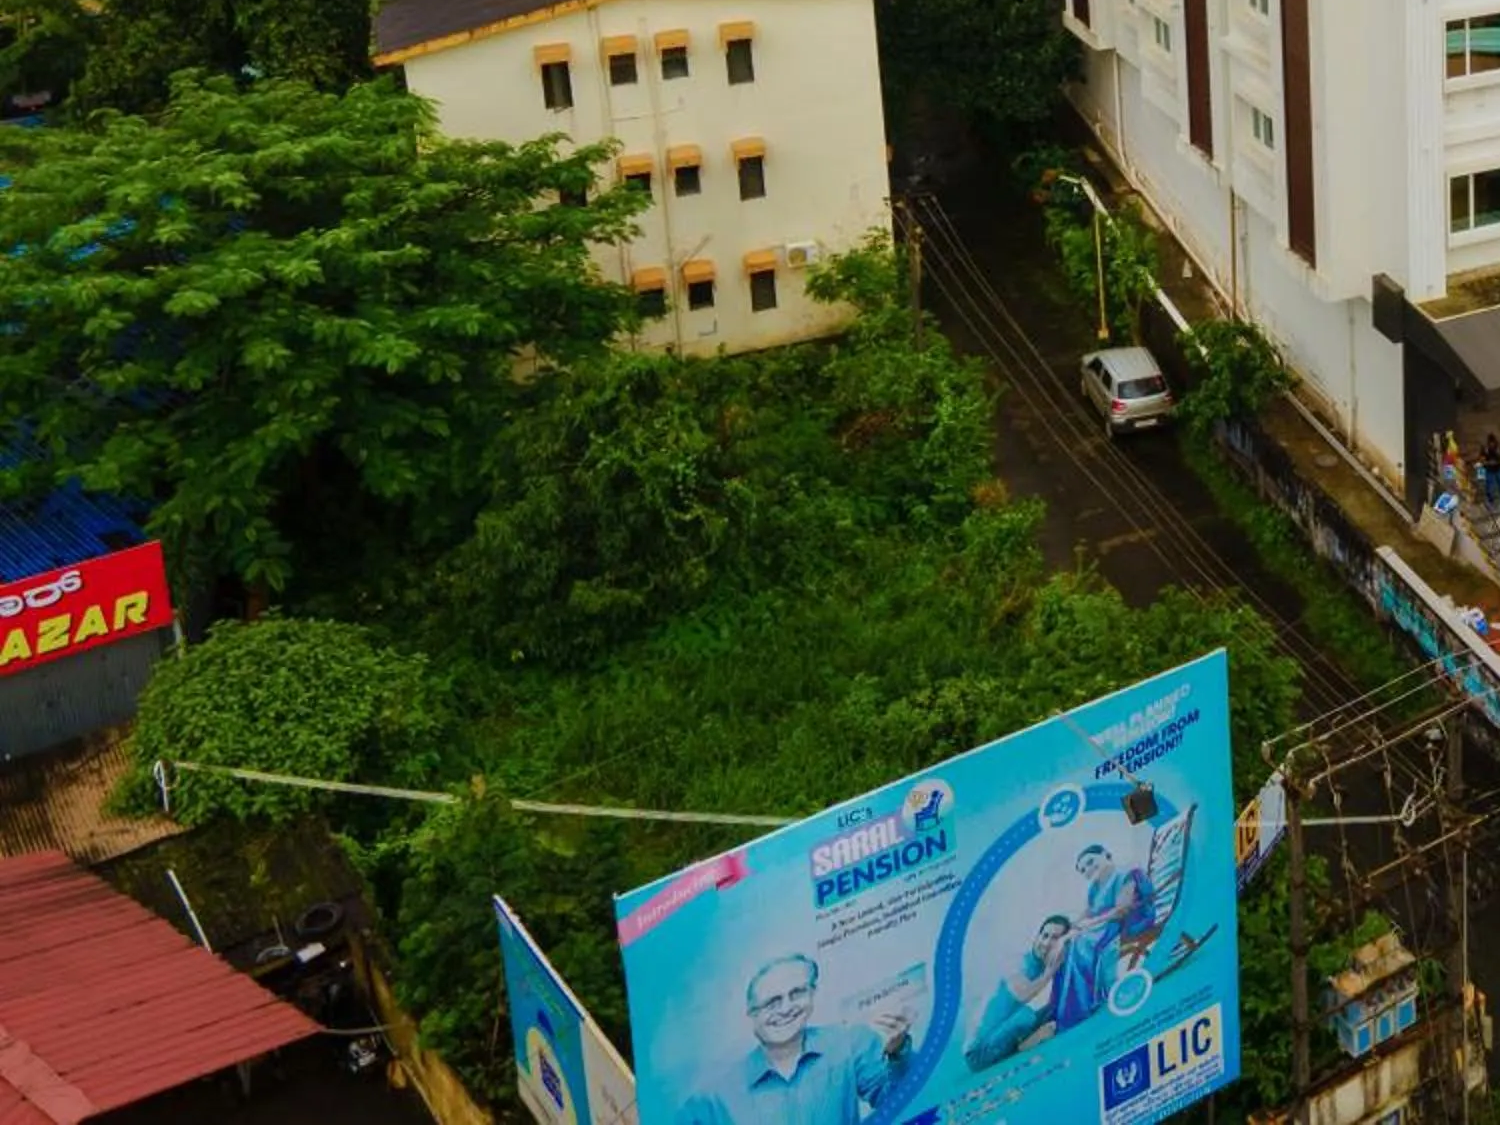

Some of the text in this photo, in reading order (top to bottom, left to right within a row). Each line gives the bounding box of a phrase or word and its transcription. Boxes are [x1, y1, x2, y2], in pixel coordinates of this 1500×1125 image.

[1162, 708, 1200, 742] FROM
[812, 818, 905, 876] SARAL
[816, 829, 947, 906] PENSION
[1157, 1016, 1213, 1076] LIC
